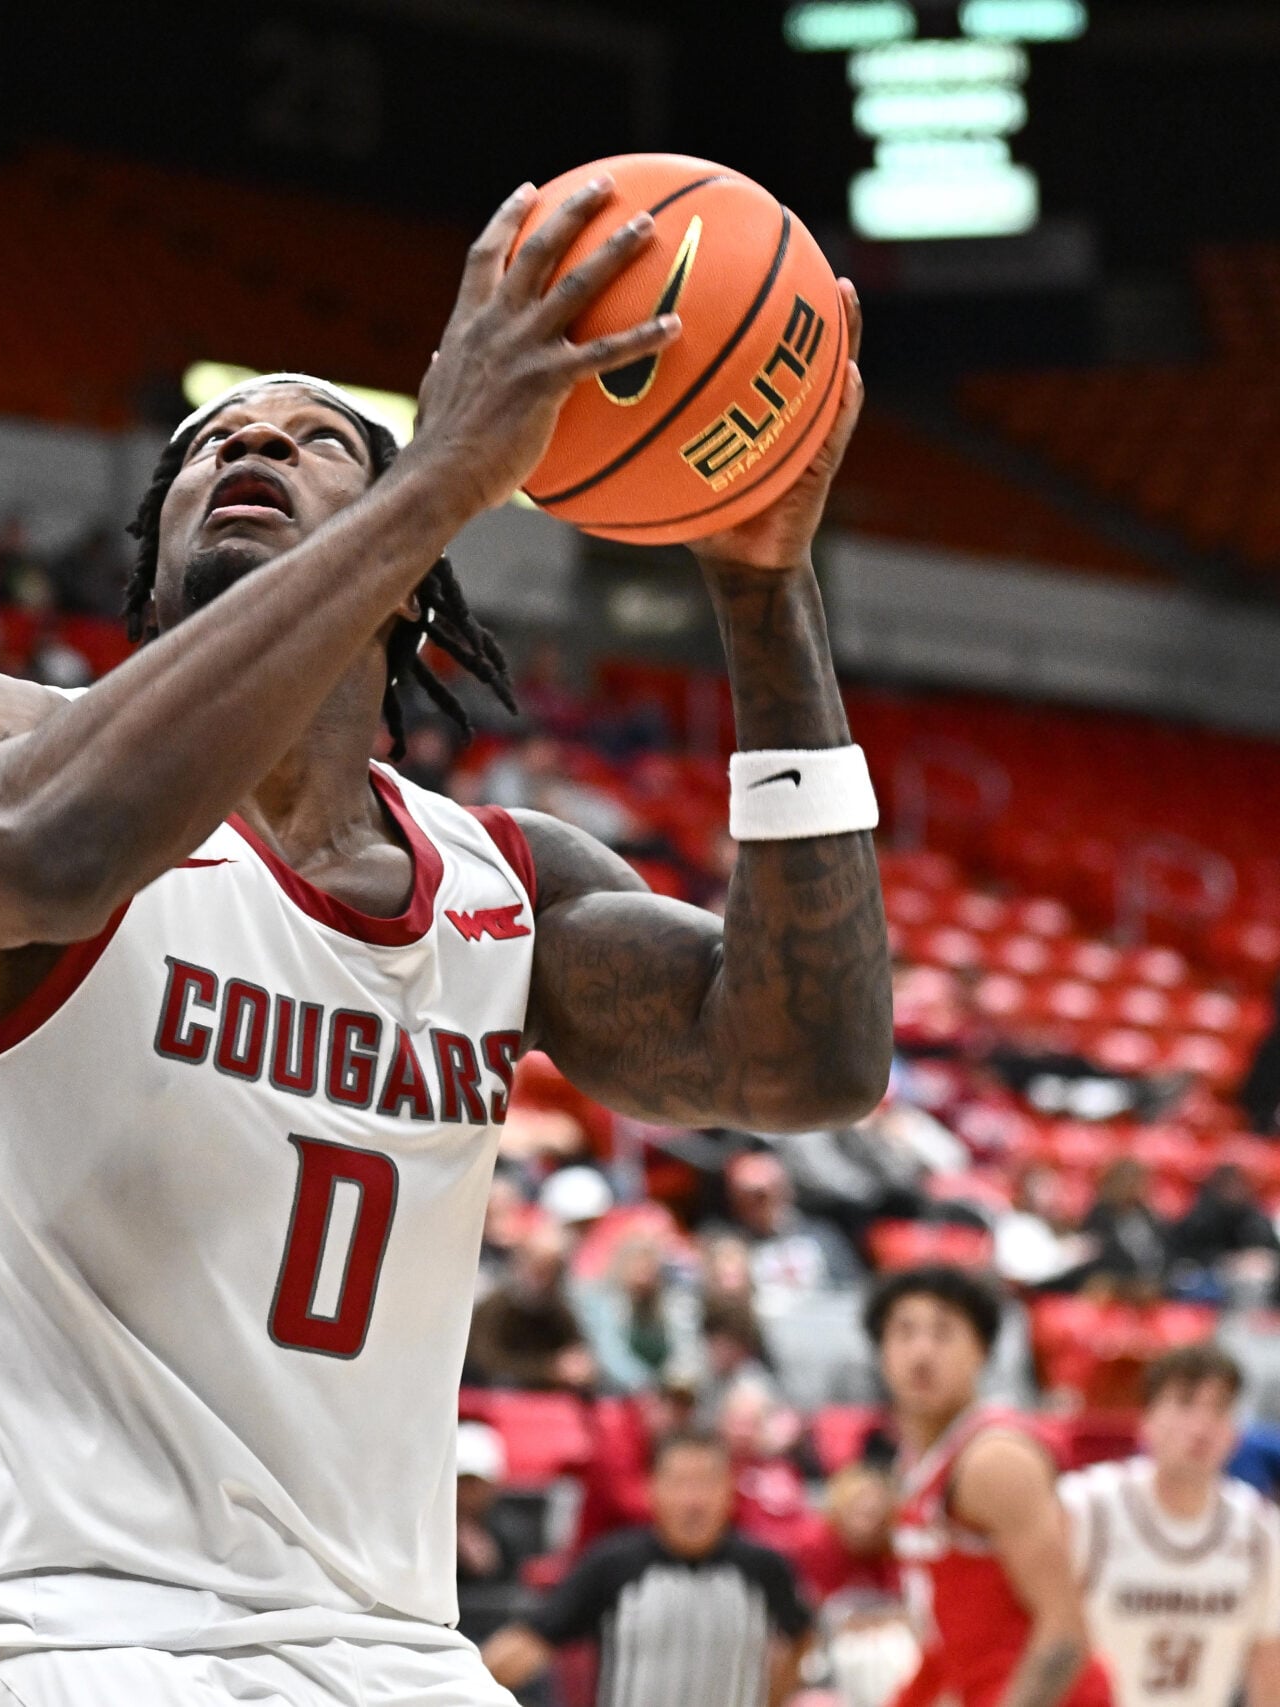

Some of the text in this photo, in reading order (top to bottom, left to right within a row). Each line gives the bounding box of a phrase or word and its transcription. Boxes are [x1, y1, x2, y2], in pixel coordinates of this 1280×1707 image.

[679, 293, 824, 481] ELITE
[153, 955, 522, 1127] COUGARS
[267, 1132, 400, 1362] 0
